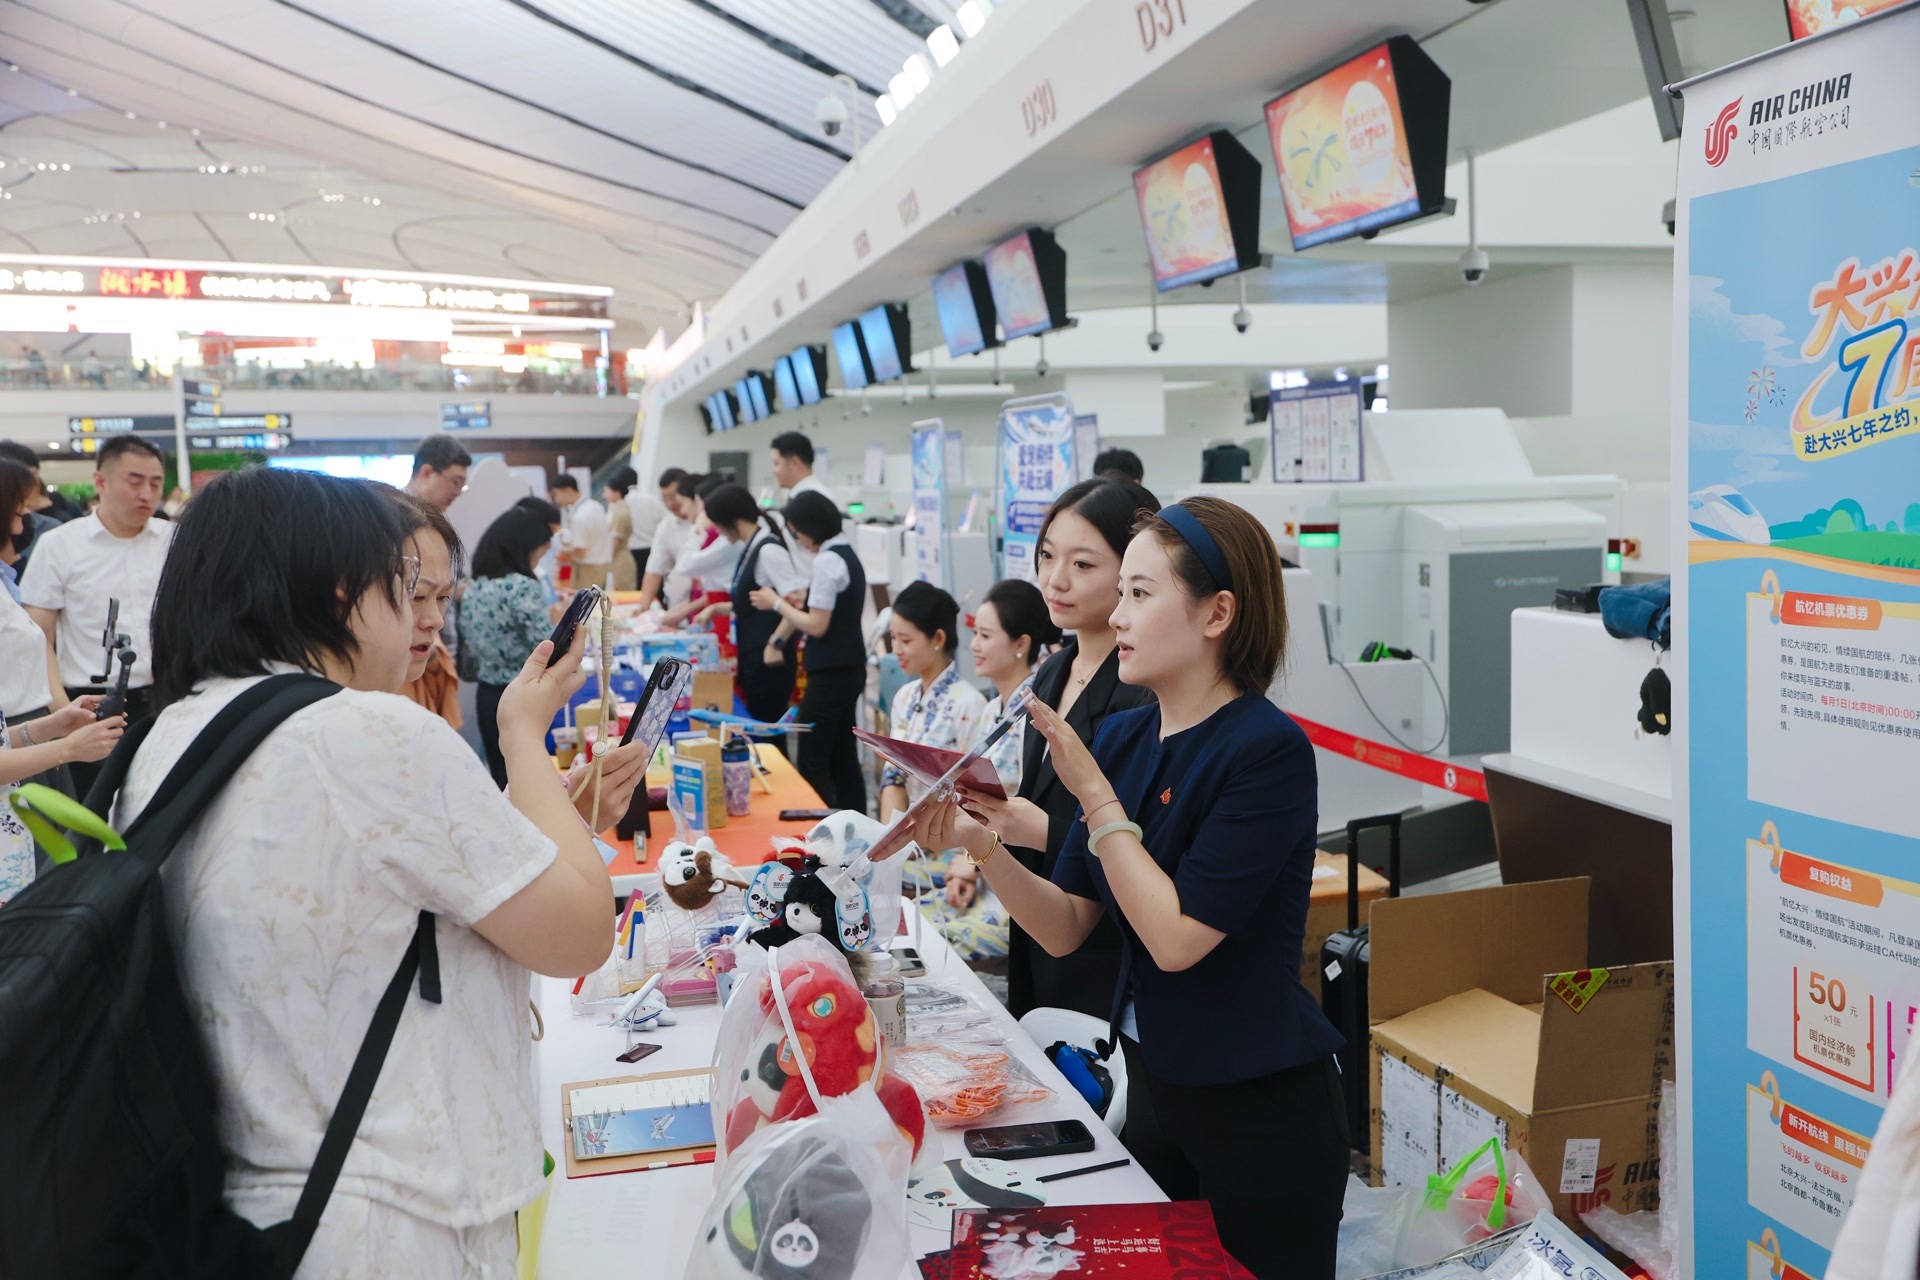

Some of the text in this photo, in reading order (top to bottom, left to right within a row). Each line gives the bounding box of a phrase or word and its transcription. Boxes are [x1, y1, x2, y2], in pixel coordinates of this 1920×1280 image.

[1749, 73, 1852, 126] AIR CHINA
[1795, 599, 1869, 621] 航忆机票优惠券
[1780, 637, 1920, 666] 航忆大兴的初见，情续国航的陪伴，几张
[1780, 654, 1920, 683] 惠券，是国航为老朋友们准备的重逢帖，
[1809, 867, 1852, 892] 复购权益
[1808, 971, 1858, 1017] 50 元
[1809, 1029, 1856, 1058] 国内经济舱
[1813, 1044, 1851, 1067] 机票优惠券
[1788, 1113, 1829, 1144] 新开航线
[1780, 1142, 1848, 1183] 飞的越多 收获越多
